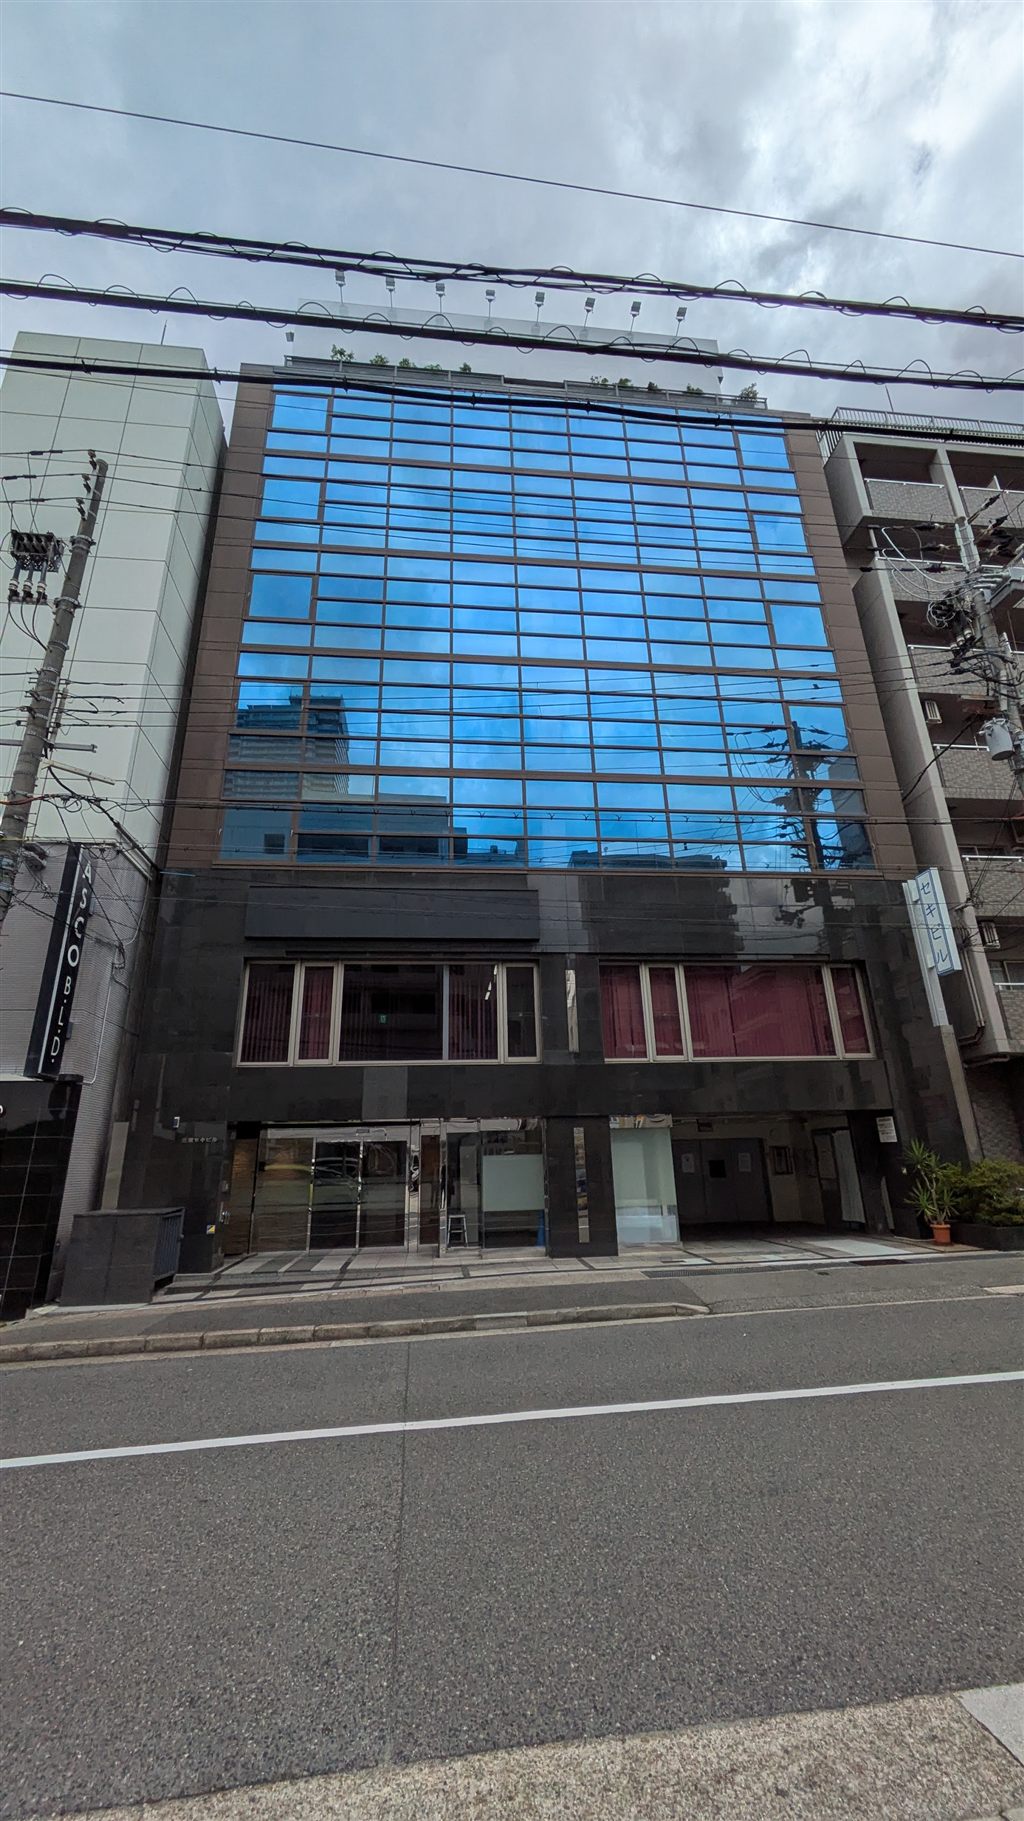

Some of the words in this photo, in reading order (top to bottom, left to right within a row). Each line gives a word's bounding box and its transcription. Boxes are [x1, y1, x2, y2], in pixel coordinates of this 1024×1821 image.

[67, 860, 92, 968] ASCO
[920, 882, 949, 964] セキビル
